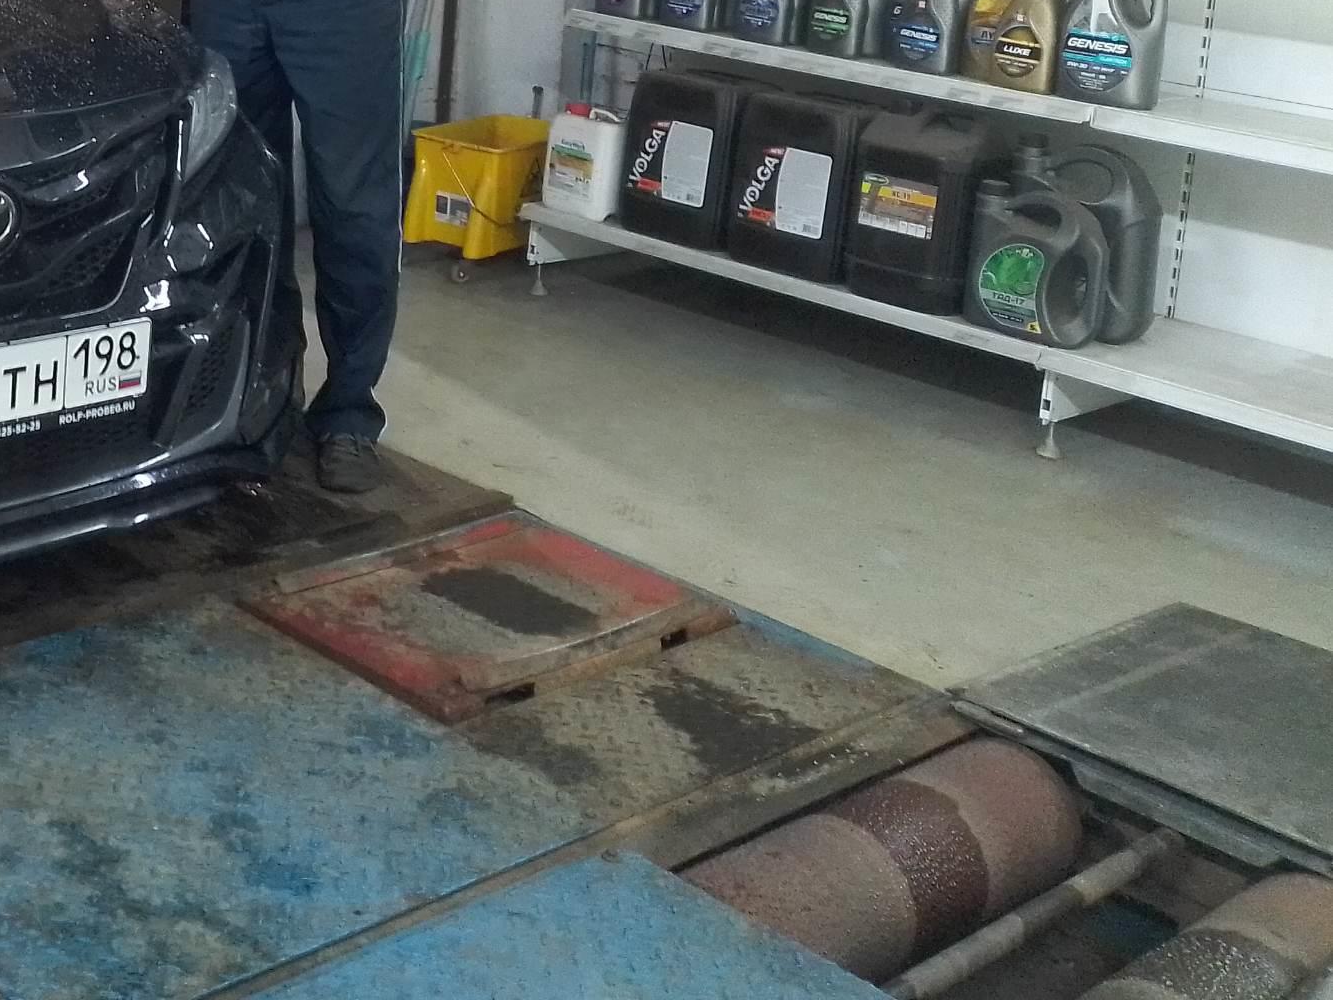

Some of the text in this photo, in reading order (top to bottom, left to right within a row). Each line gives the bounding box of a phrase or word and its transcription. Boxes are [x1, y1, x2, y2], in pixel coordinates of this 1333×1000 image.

[899, 28, 938, 42] GENESIS
[1067, 36, 1129, 55] GENESIS
[1003, 44, 1032, 57] LUXE
[629, 128, 666, 182] VOLGA
[738, 154, 780, 213] VOLGA
[73, 331, 137, 379] 198
[84, 376, 117, 398] RUS
